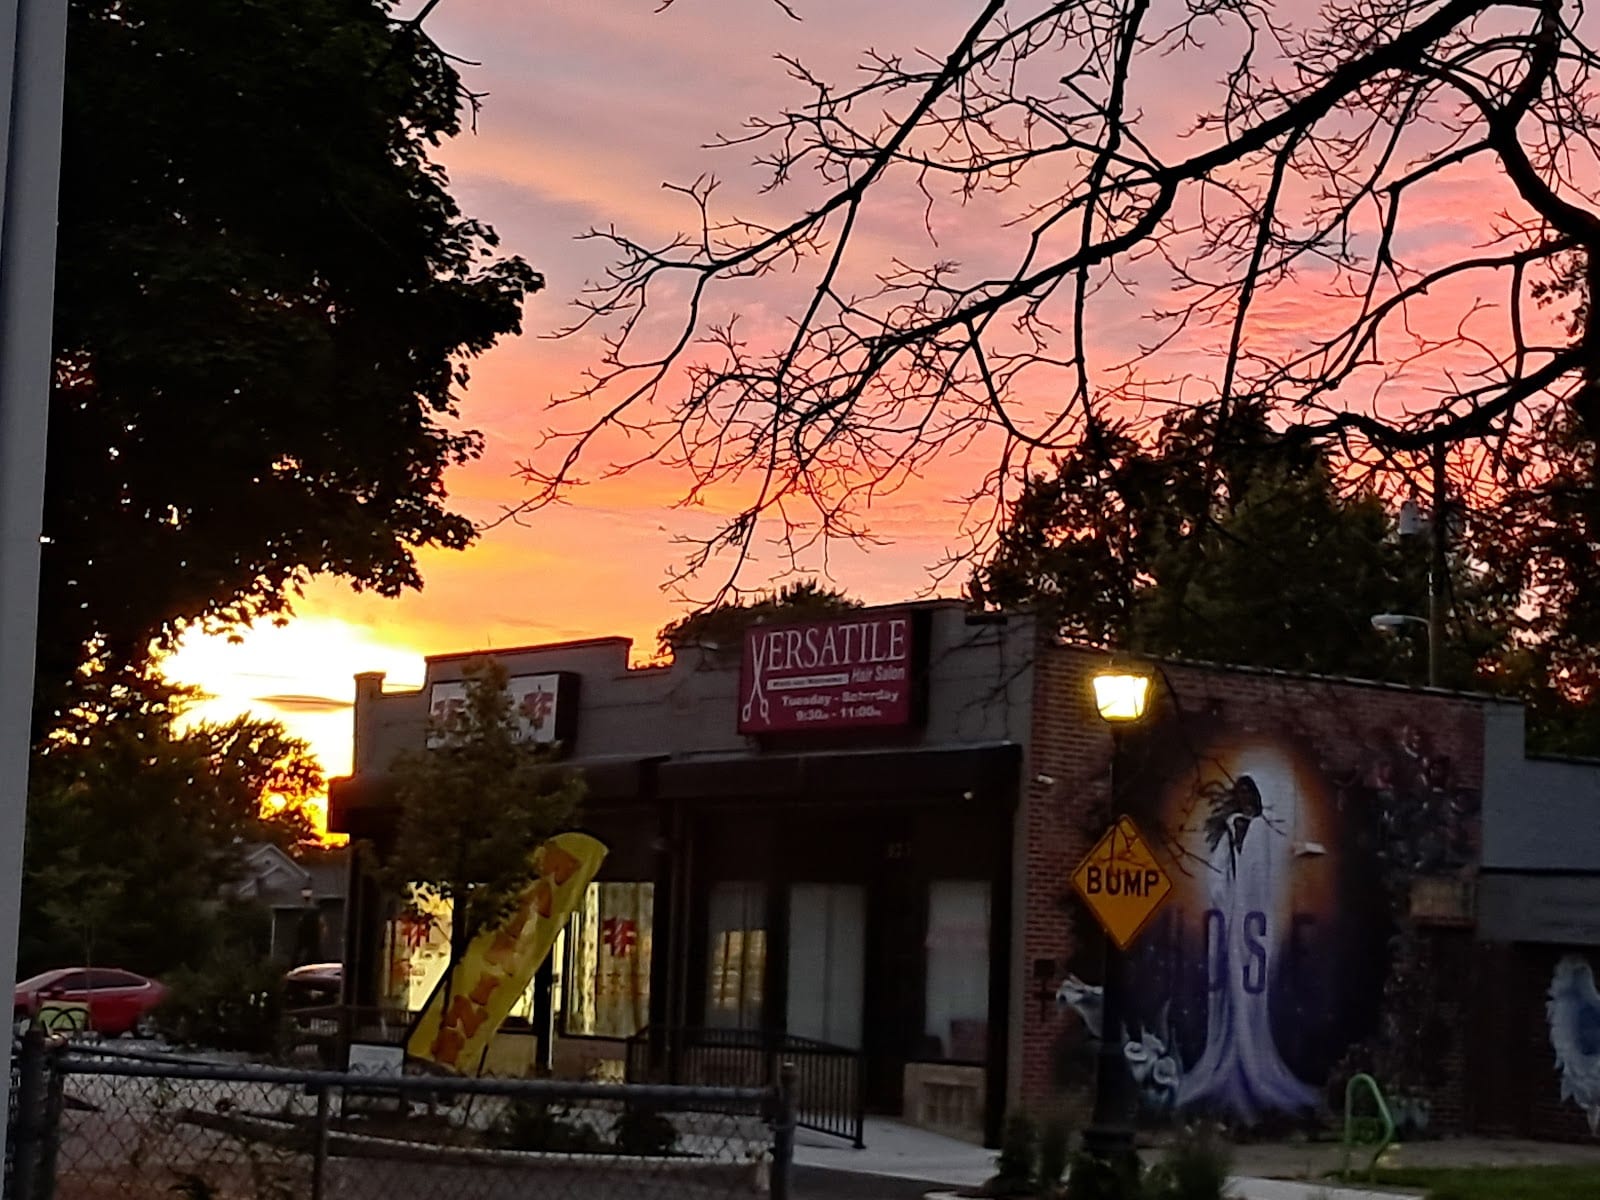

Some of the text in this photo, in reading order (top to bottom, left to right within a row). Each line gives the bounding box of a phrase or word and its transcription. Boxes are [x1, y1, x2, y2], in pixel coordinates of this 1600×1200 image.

[752, 619, 906, 671] VERSATILE
[874, 664, 905, 682] Salon
[781, 694, 832, 706] Tuesday
[1086, 866, 1159, 896] BUMP
